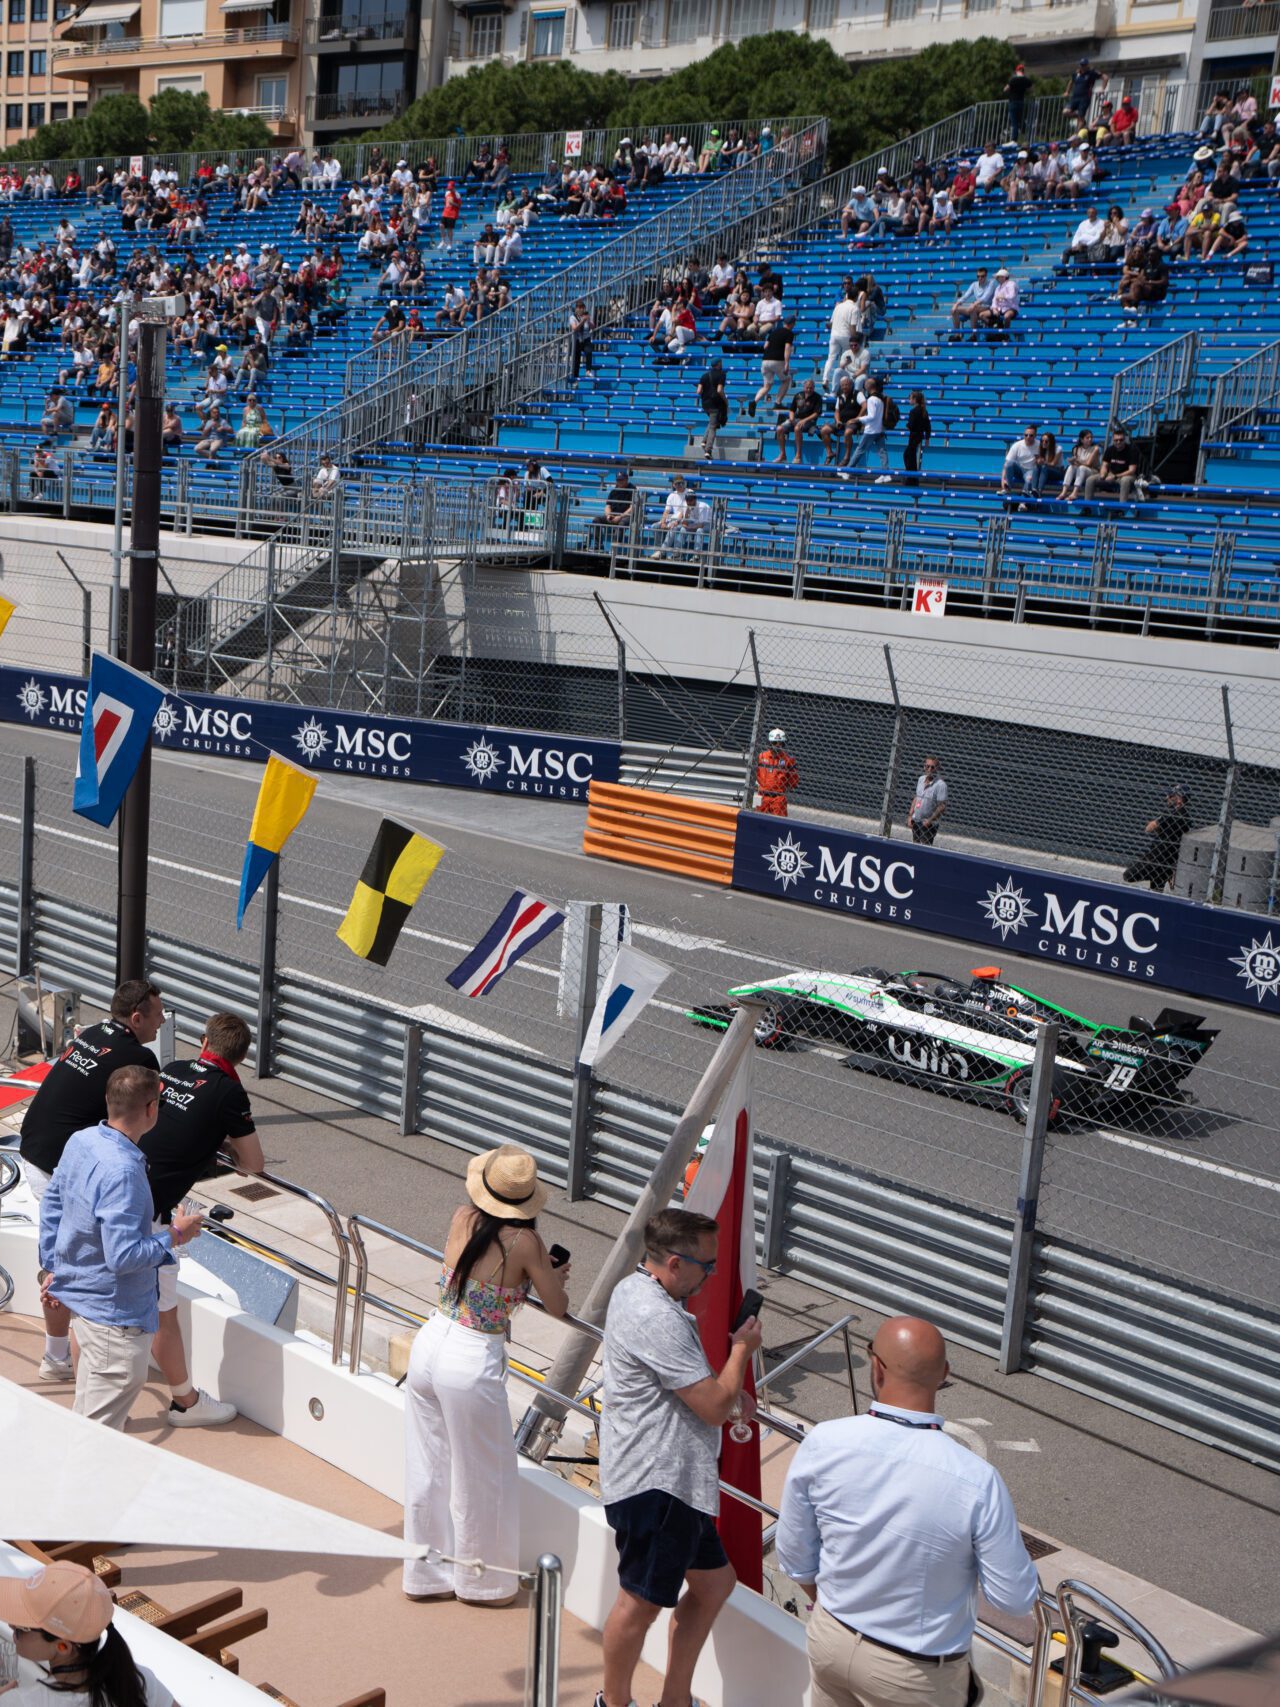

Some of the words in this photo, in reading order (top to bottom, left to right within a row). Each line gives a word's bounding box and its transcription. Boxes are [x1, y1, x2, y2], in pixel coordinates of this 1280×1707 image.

[49, 685, 88, 716] MS
[183, 706, 252, 741] MSC
[182, 737, 251, 755] CRUISES
[334, 725, 412, 761] MSC
[333, 758, 411, 776] CRUISES
[507, 745, 593, 783] MSC
[815, 846, 915, 899] MSC
[814, 888, 912, 920] CRUISES
[1040, 892, 1160, 953] MSC
[1038, 939, 1155, 976] CRUISES
[69, 1050, 98, 1070] Red7
[1101, 1050, 1138, 1065] MOTOREX
[181, 1080, 195, 1088] Red
[1104, 1063, 1138, 1092] 19
[162, 1086, 195, 1105] Red7
[175, 1102, 188, 1112] PRIX
